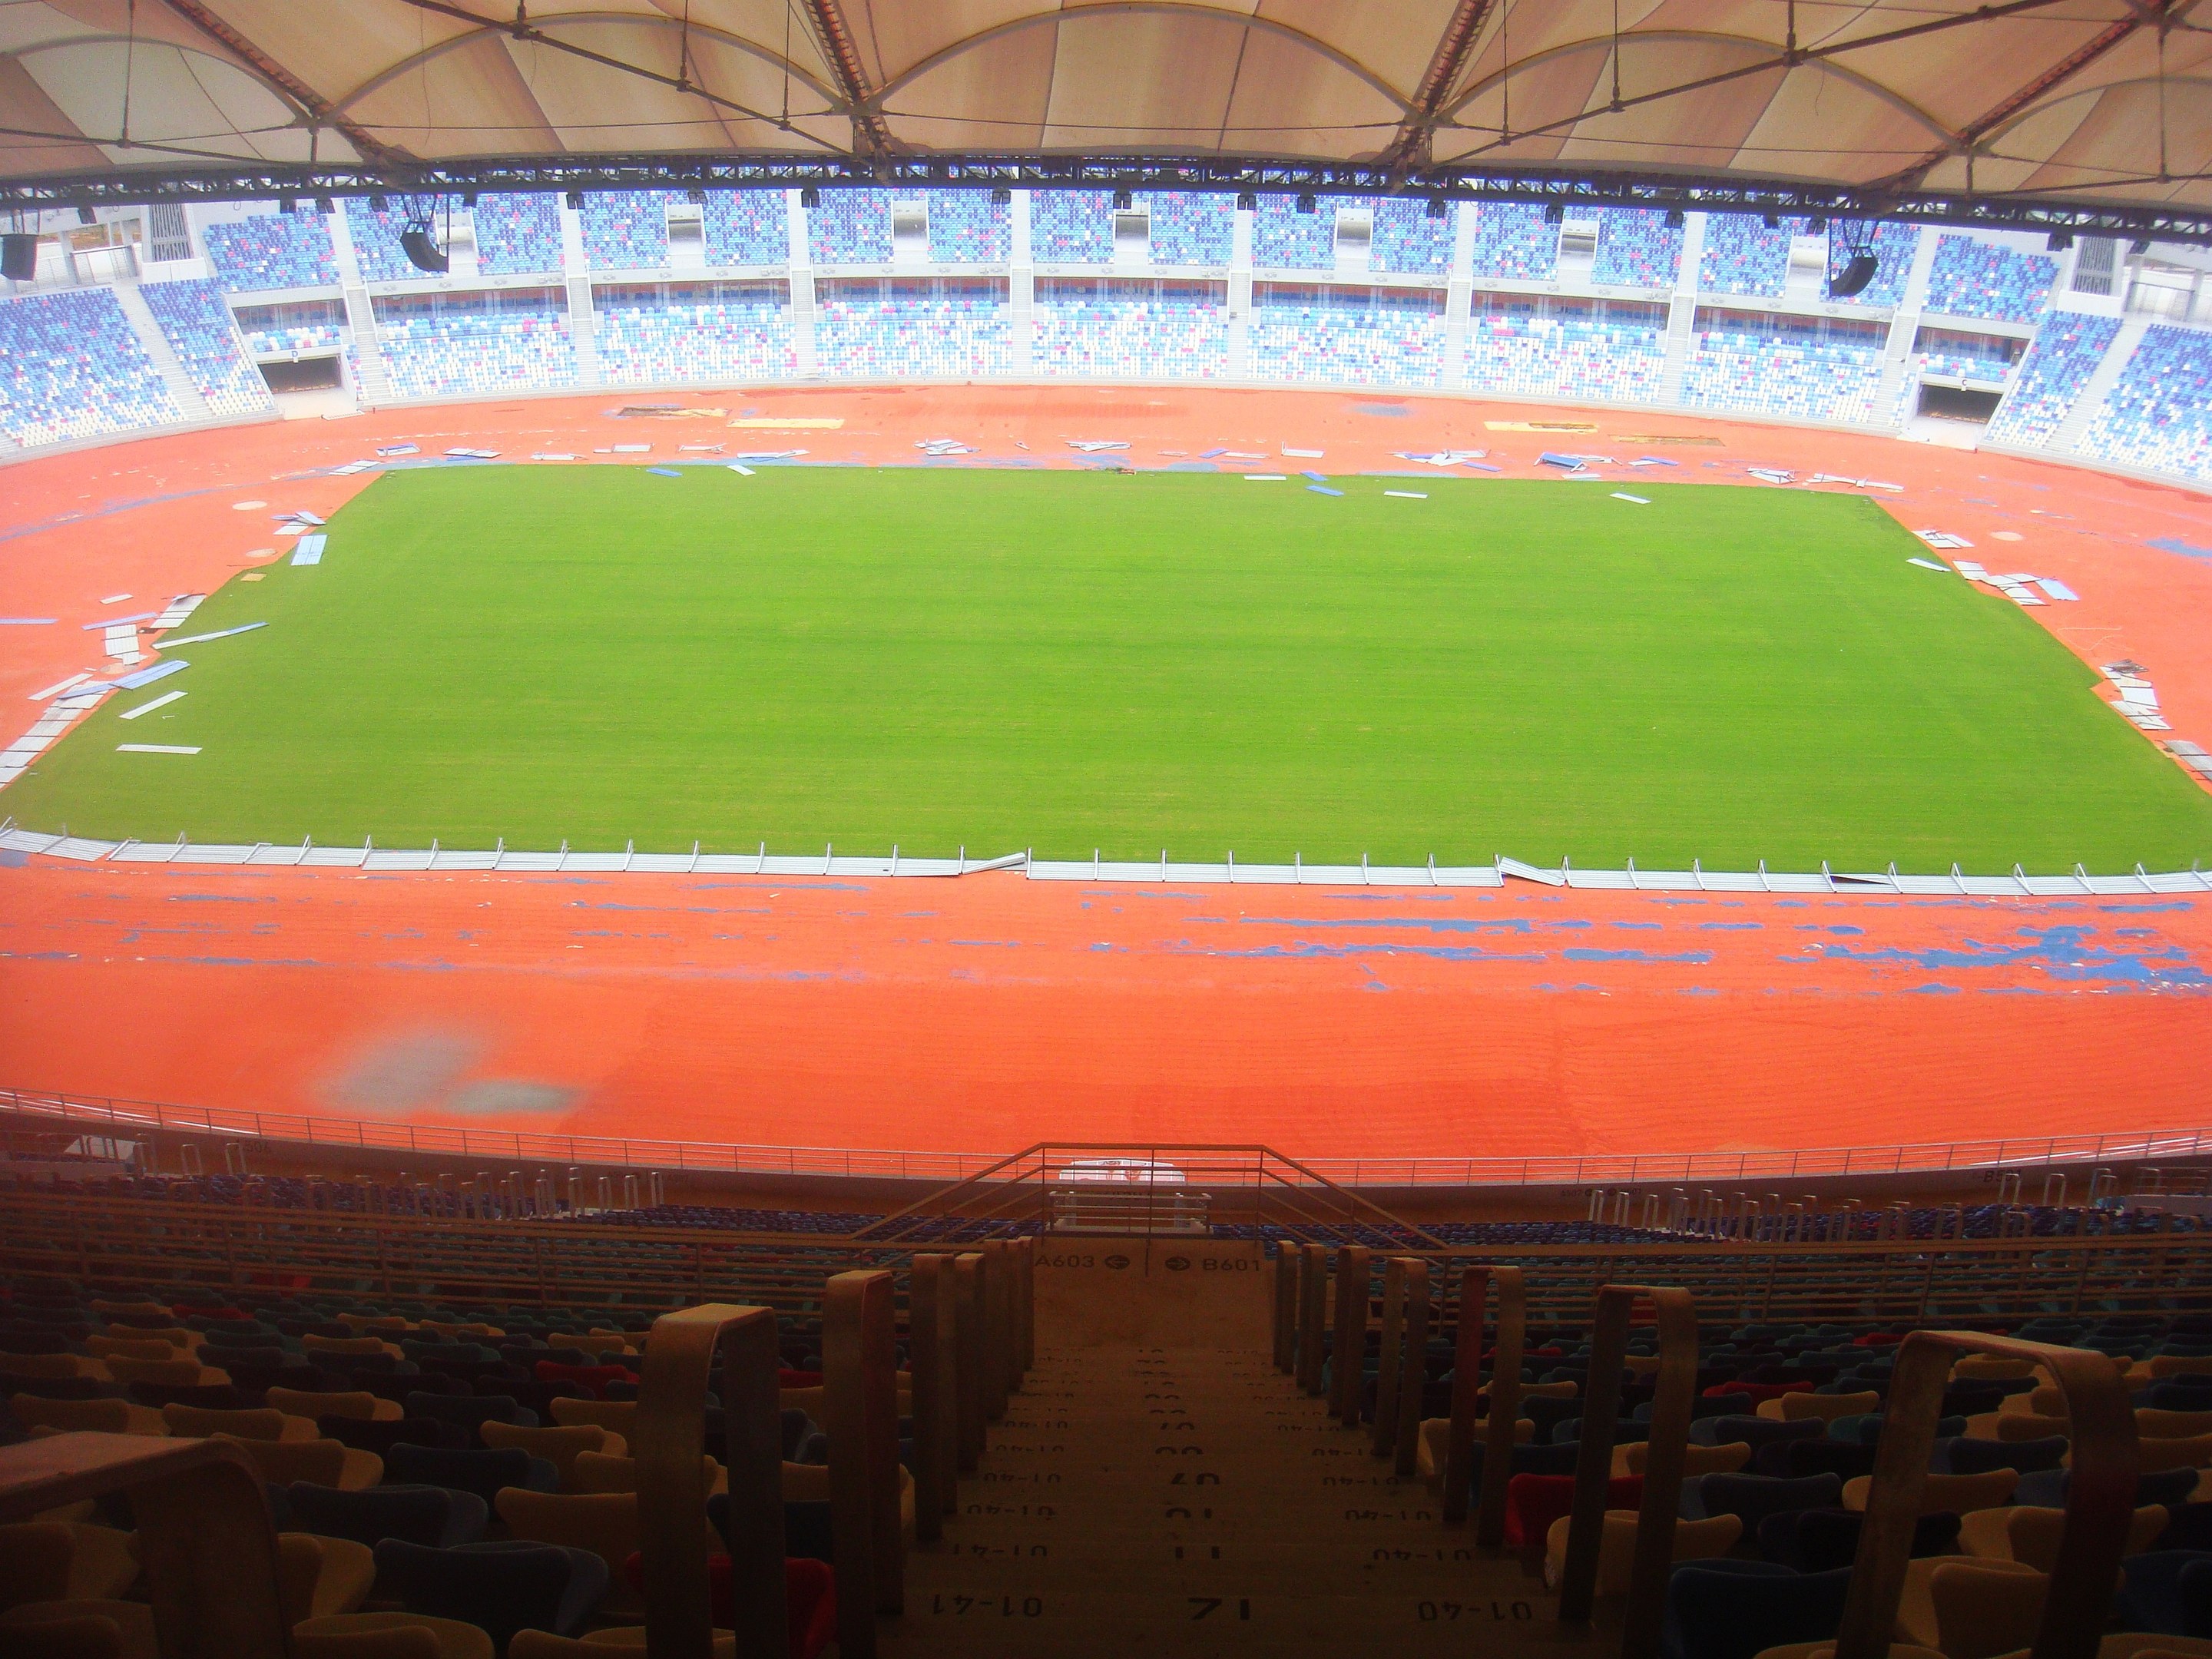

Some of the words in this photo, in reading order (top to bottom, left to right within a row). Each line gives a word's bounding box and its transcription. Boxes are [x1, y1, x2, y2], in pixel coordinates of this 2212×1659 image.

[1035, 1254, 1094, 1267] A603
[1203, 1258, 1260, 1271] B601
[932, 1594, 1043, 1618] 01-41
[1187, 1597, 1250, 1621] 12
[1418, 1600, 1533, 1621] 01-40
